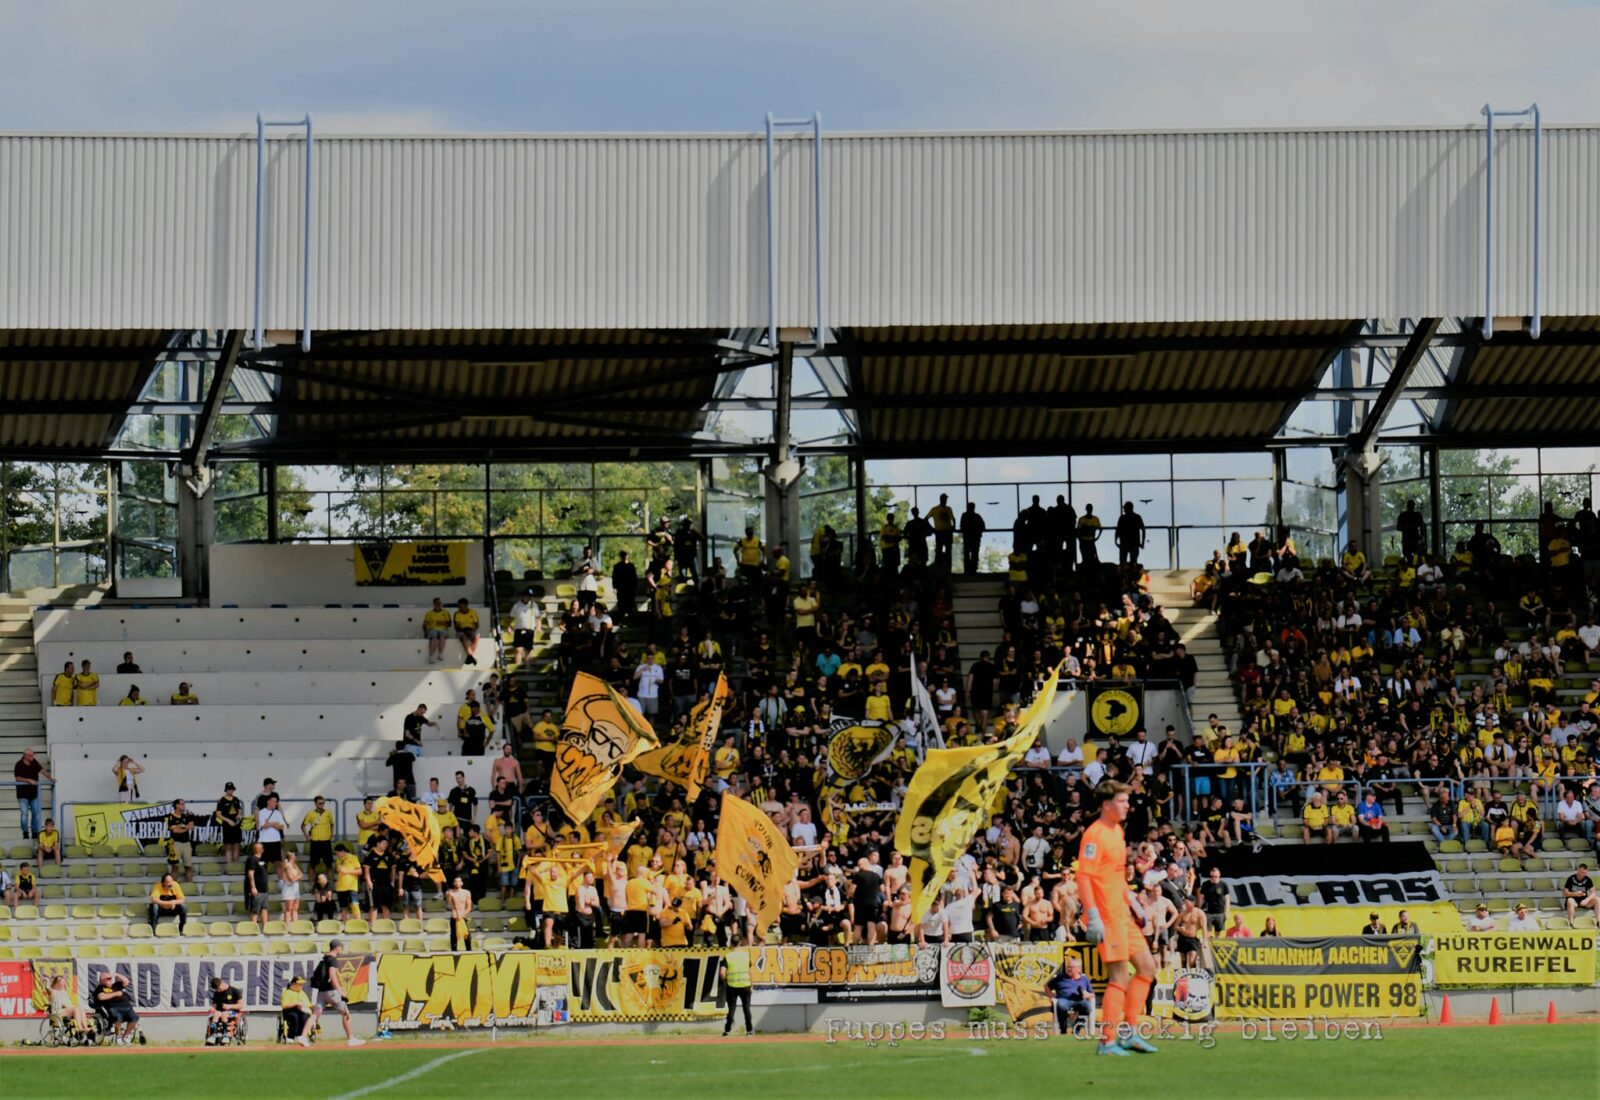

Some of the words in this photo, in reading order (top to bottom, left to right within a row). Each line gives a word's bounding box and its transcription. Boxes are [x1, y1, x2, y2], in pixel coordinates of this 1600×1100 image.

[1436, 934, 1594, 951] HÜRTGENWALD
[1237, 947, 1324, 966] ALEMANNIA
[1327, 946, 1389, 965] AACHEN
[1456, 956, 1577, 973] RUREIFEL
[1304, 982, 1381, 1009] POWER
[1388, 982, 1418, 1007] 98
